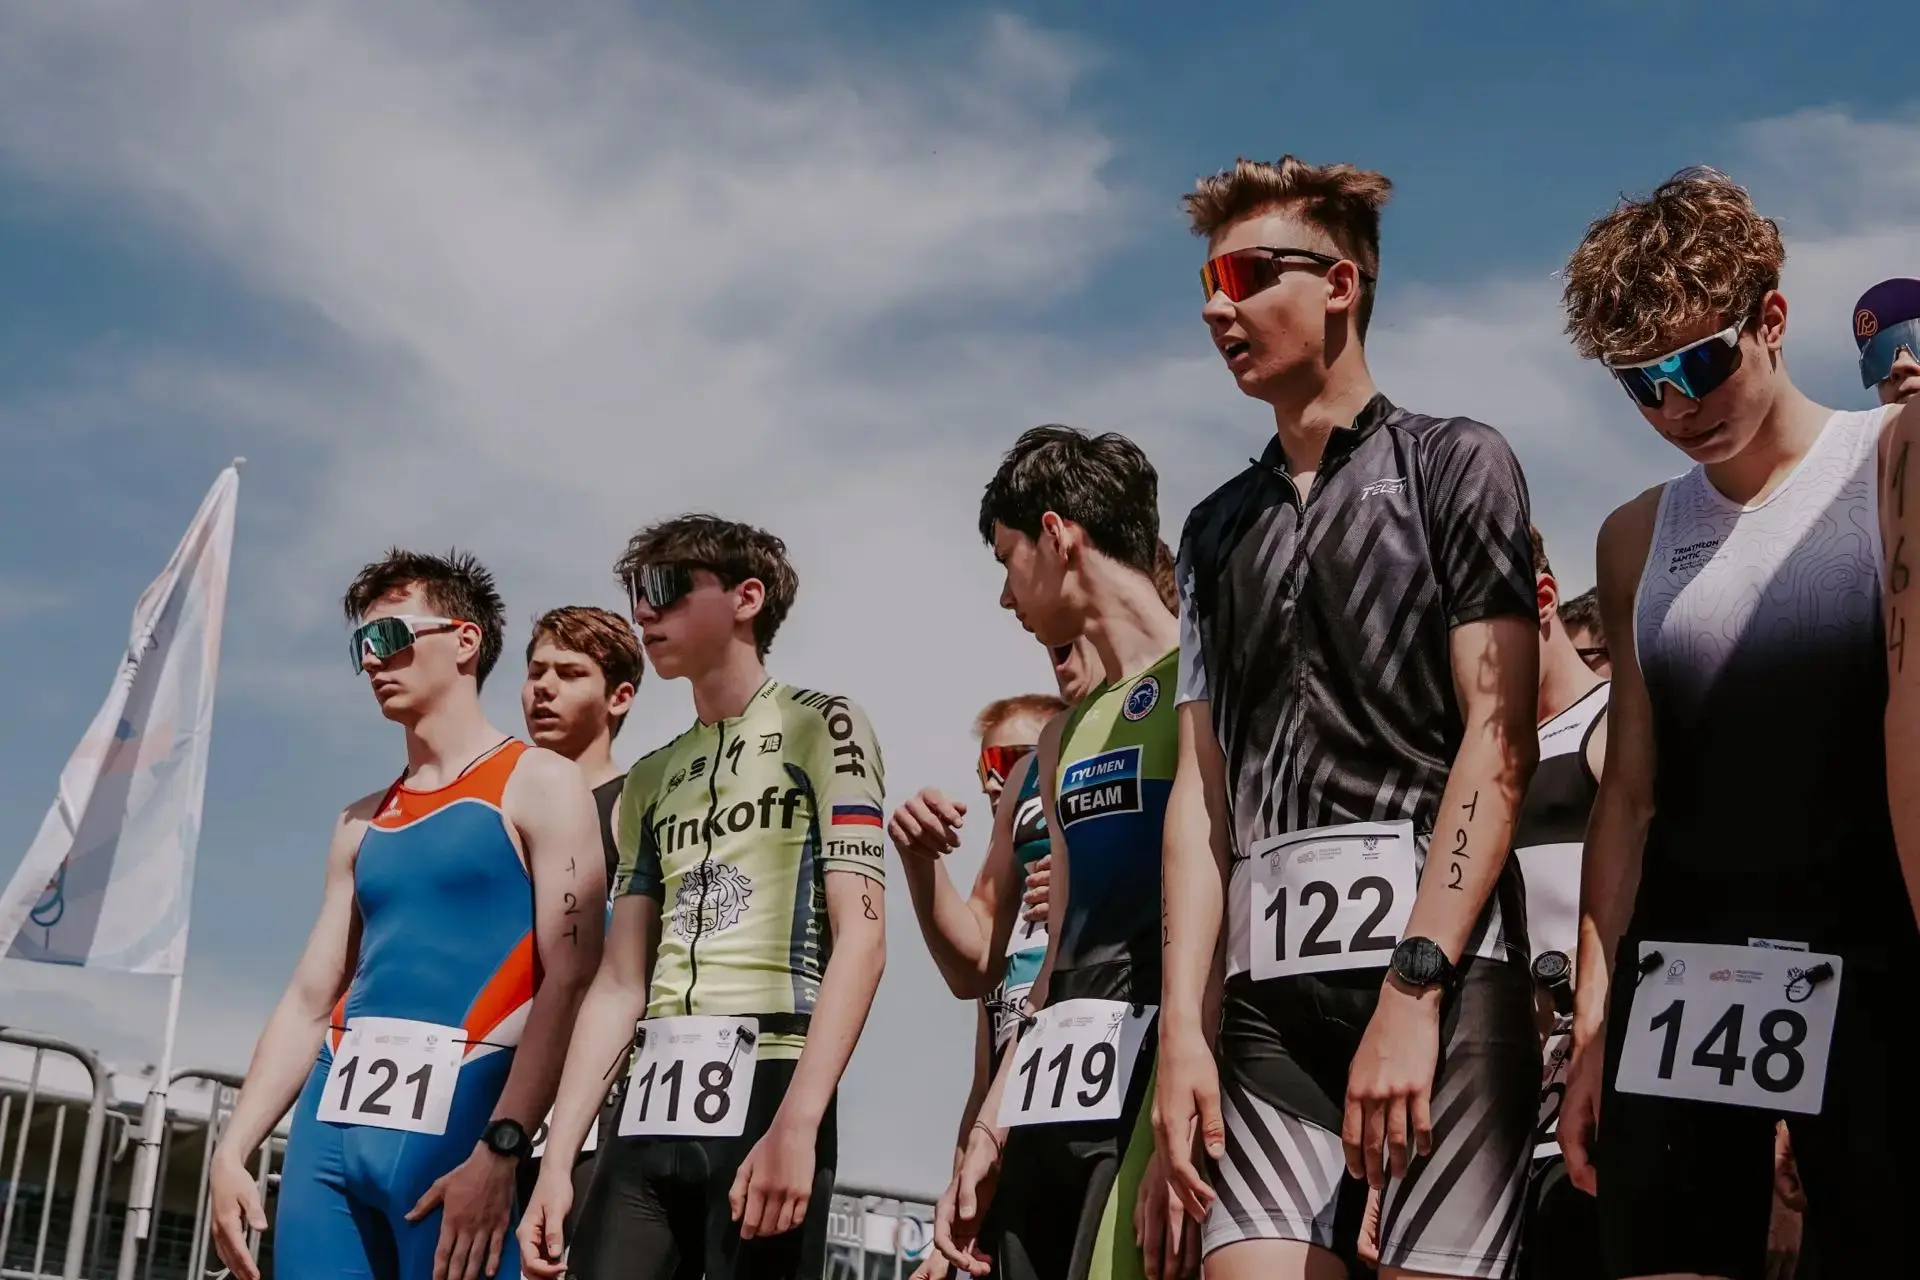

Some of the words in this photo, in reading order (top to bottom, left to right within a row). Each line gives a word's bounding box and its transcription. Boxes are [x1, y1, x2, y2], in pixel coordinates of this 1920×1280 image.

[1674, 539, 1719, 555] TRIATHLON
[1067, 785, 1123, 815] TEAM
[1070, 758, 1125, 784] TYUMEN
[826, 840, 885, 860] Tinko
[562, 856, 582, 946] 121
[1264, 875, 1397, 962] 122
[1018, 1041, 1117, 1112] 119
[1649, 999, 1808, 1094] 148
[337, 1055, 434, 1121] 121
[638, 1059, 734, 1125] 118
